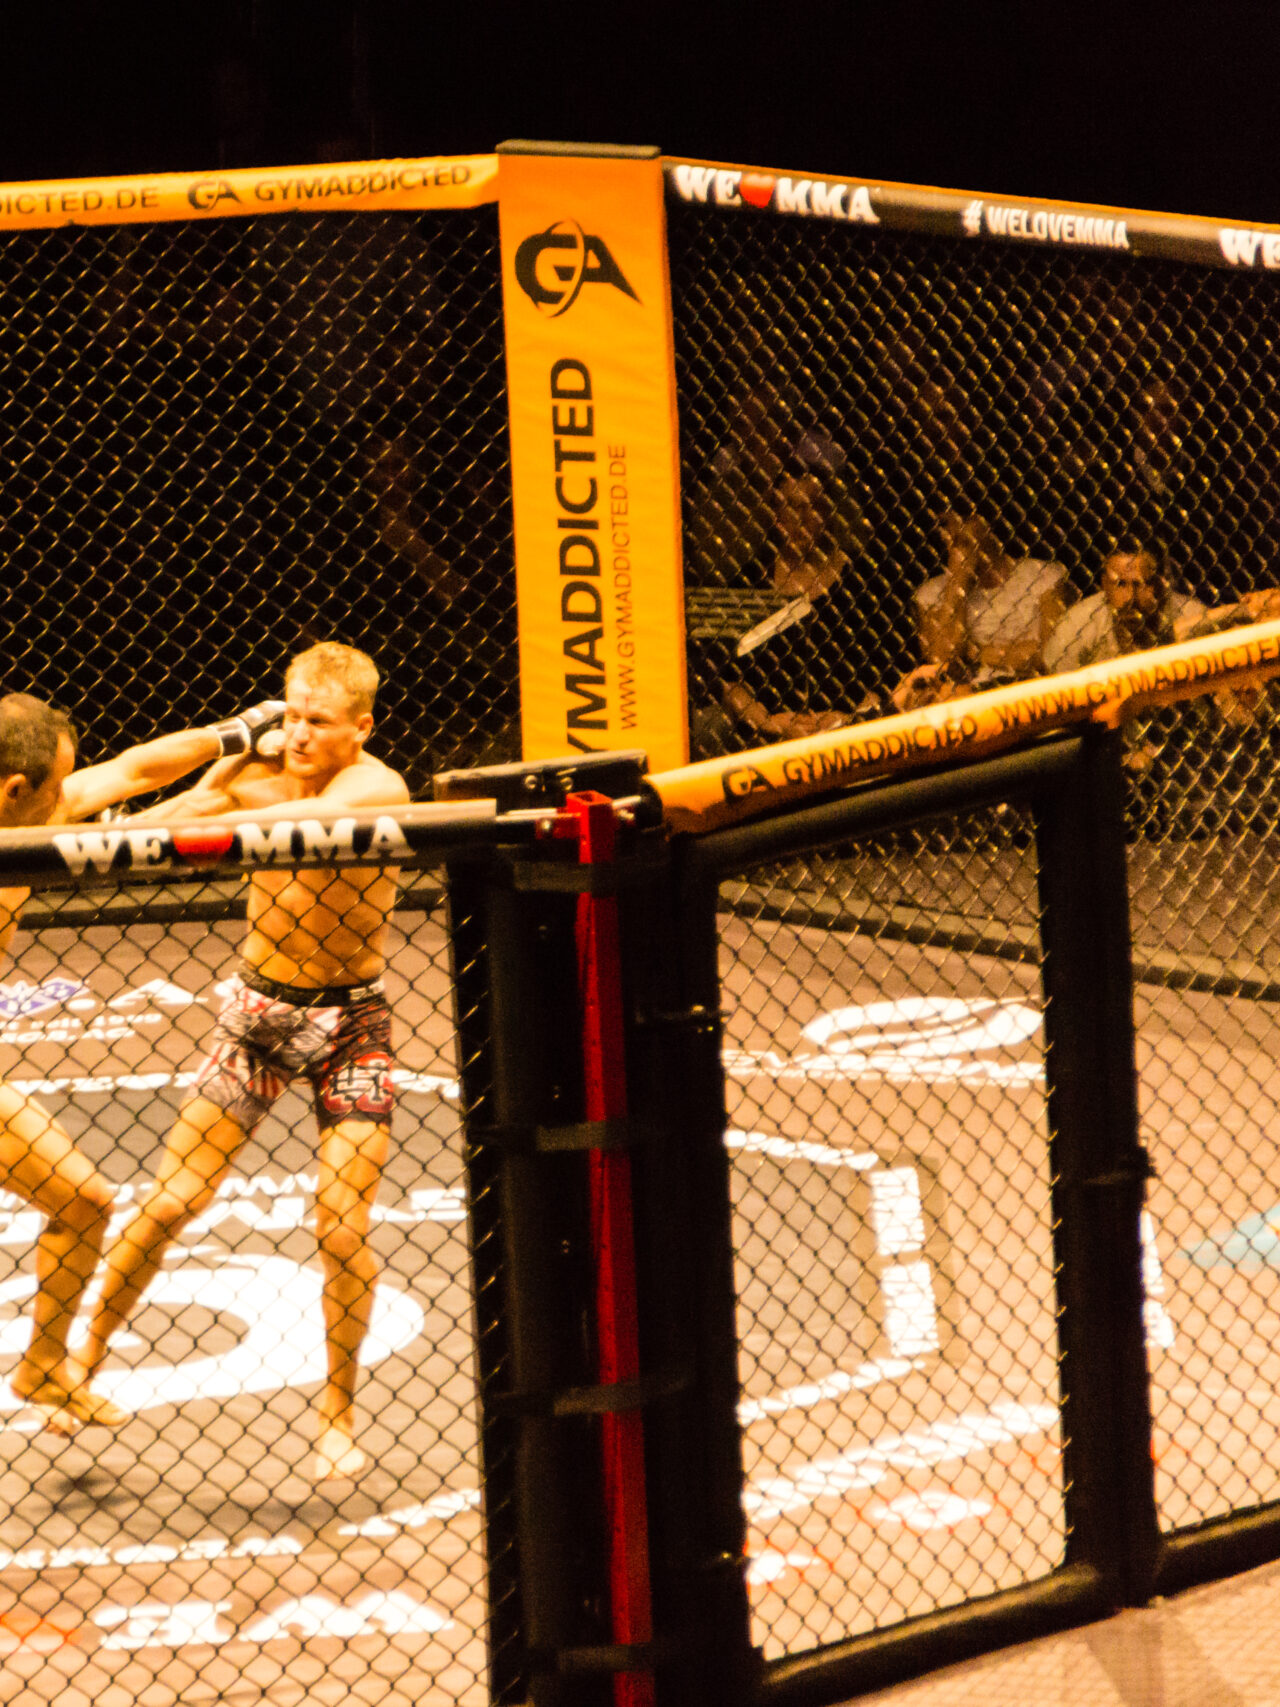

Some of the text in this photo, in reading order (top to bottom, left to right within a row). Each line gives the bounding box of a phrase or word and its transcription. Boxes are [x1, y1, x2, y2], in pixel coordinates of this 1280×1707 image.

[253, 164, 472, 203] GYMADDICTED
[672, 164, 880, 225] WE MMA
[549, 356, 610, 754] YMADDICTED
[607, 443, 638, 730] WWW.GYMADDICTED.DE
[784, 715, 979, 786] GYMADDICTED
[992, 636, 1280, 728] WWW.GYMADDICTE
[53, 815, 417, 876] WE MMA
